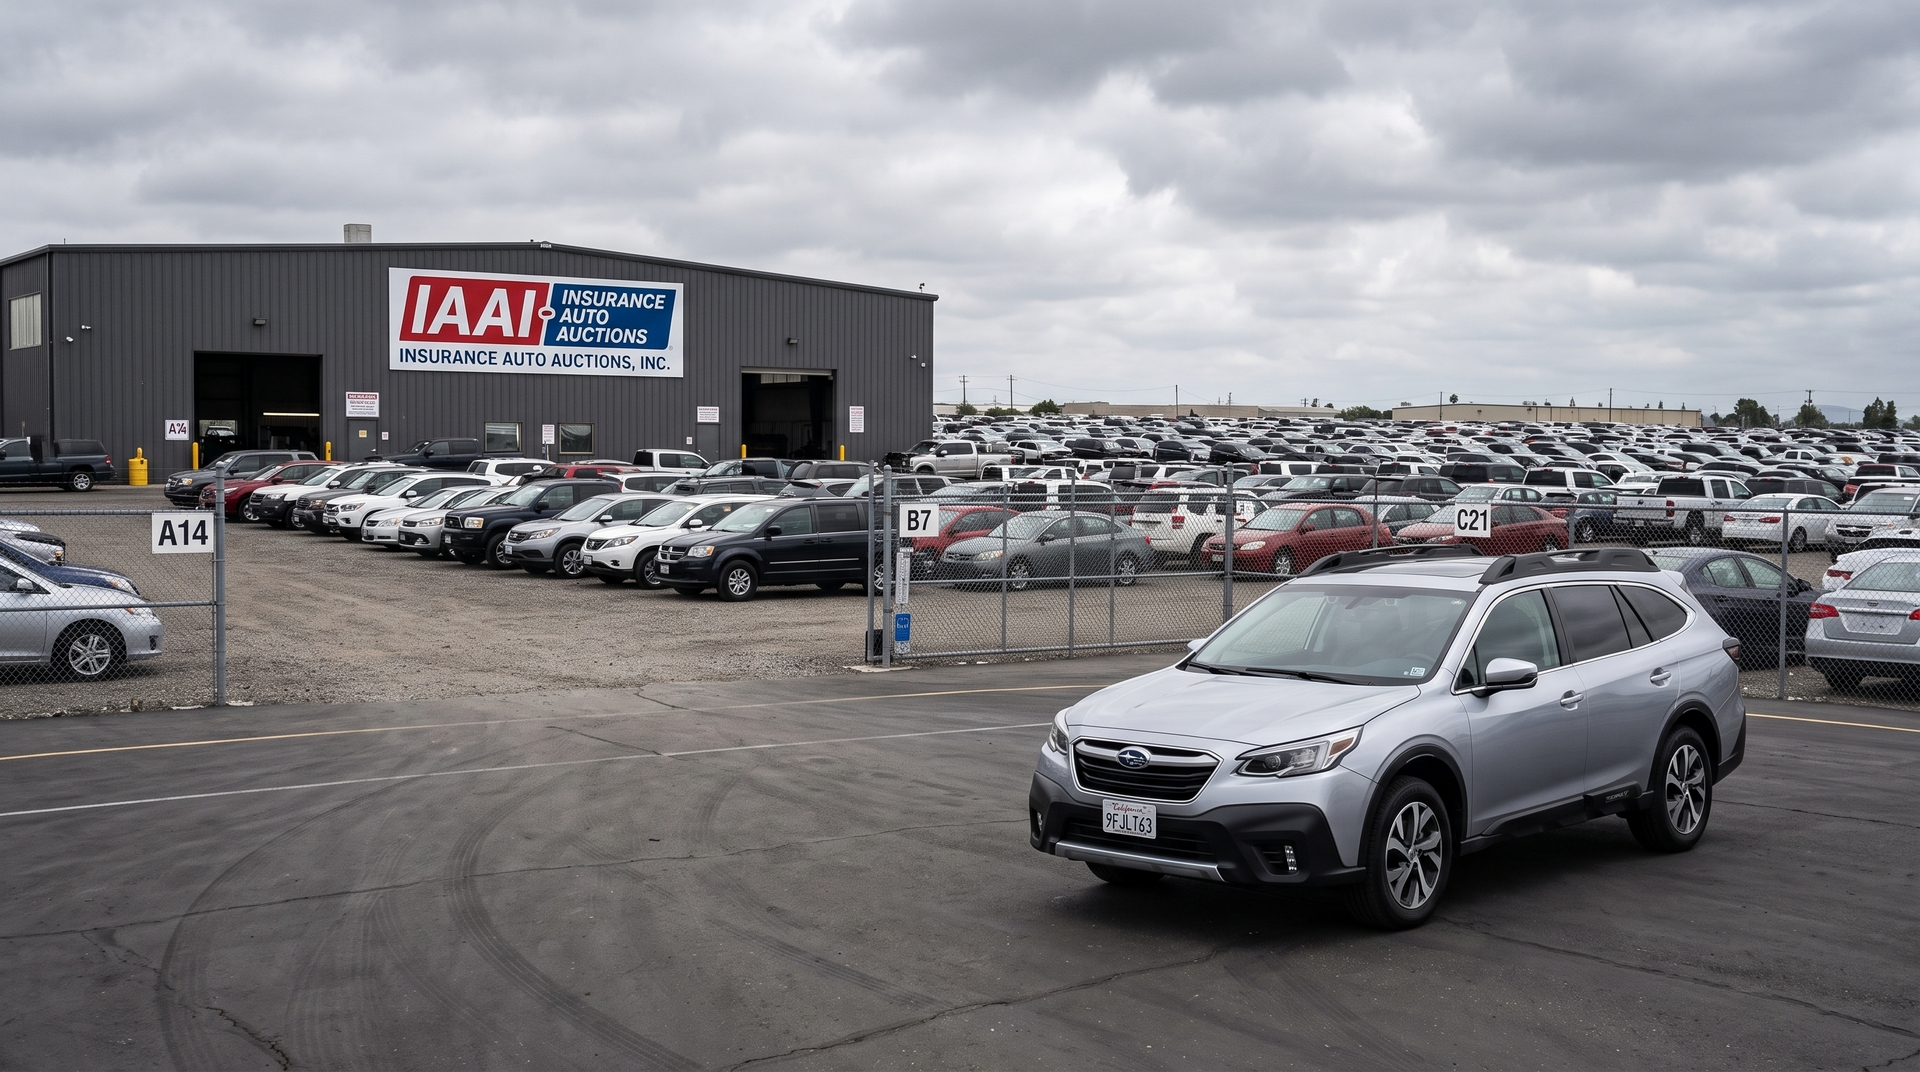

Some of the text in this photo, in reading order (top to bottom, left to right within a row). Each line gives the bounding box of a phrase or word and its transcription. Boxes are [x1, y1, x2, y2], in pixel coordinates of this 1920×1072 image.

[410, 283, 537, 338] IAAI
[561, 289, 666, 310] INSURANCE
[559, 308, 610, 325] AUTO
[555, 326, 648, 345] AUCTIONS
[399, 348, 671, 371] INSURANCE AUTO AUCTIONS, INC.
[907, 509, 932, 531] B7
[1457, 508, 1488, 531] C21
[158, 519, 209, 546] A14
[1106, 812, 1152, 833] 9FJLT63
